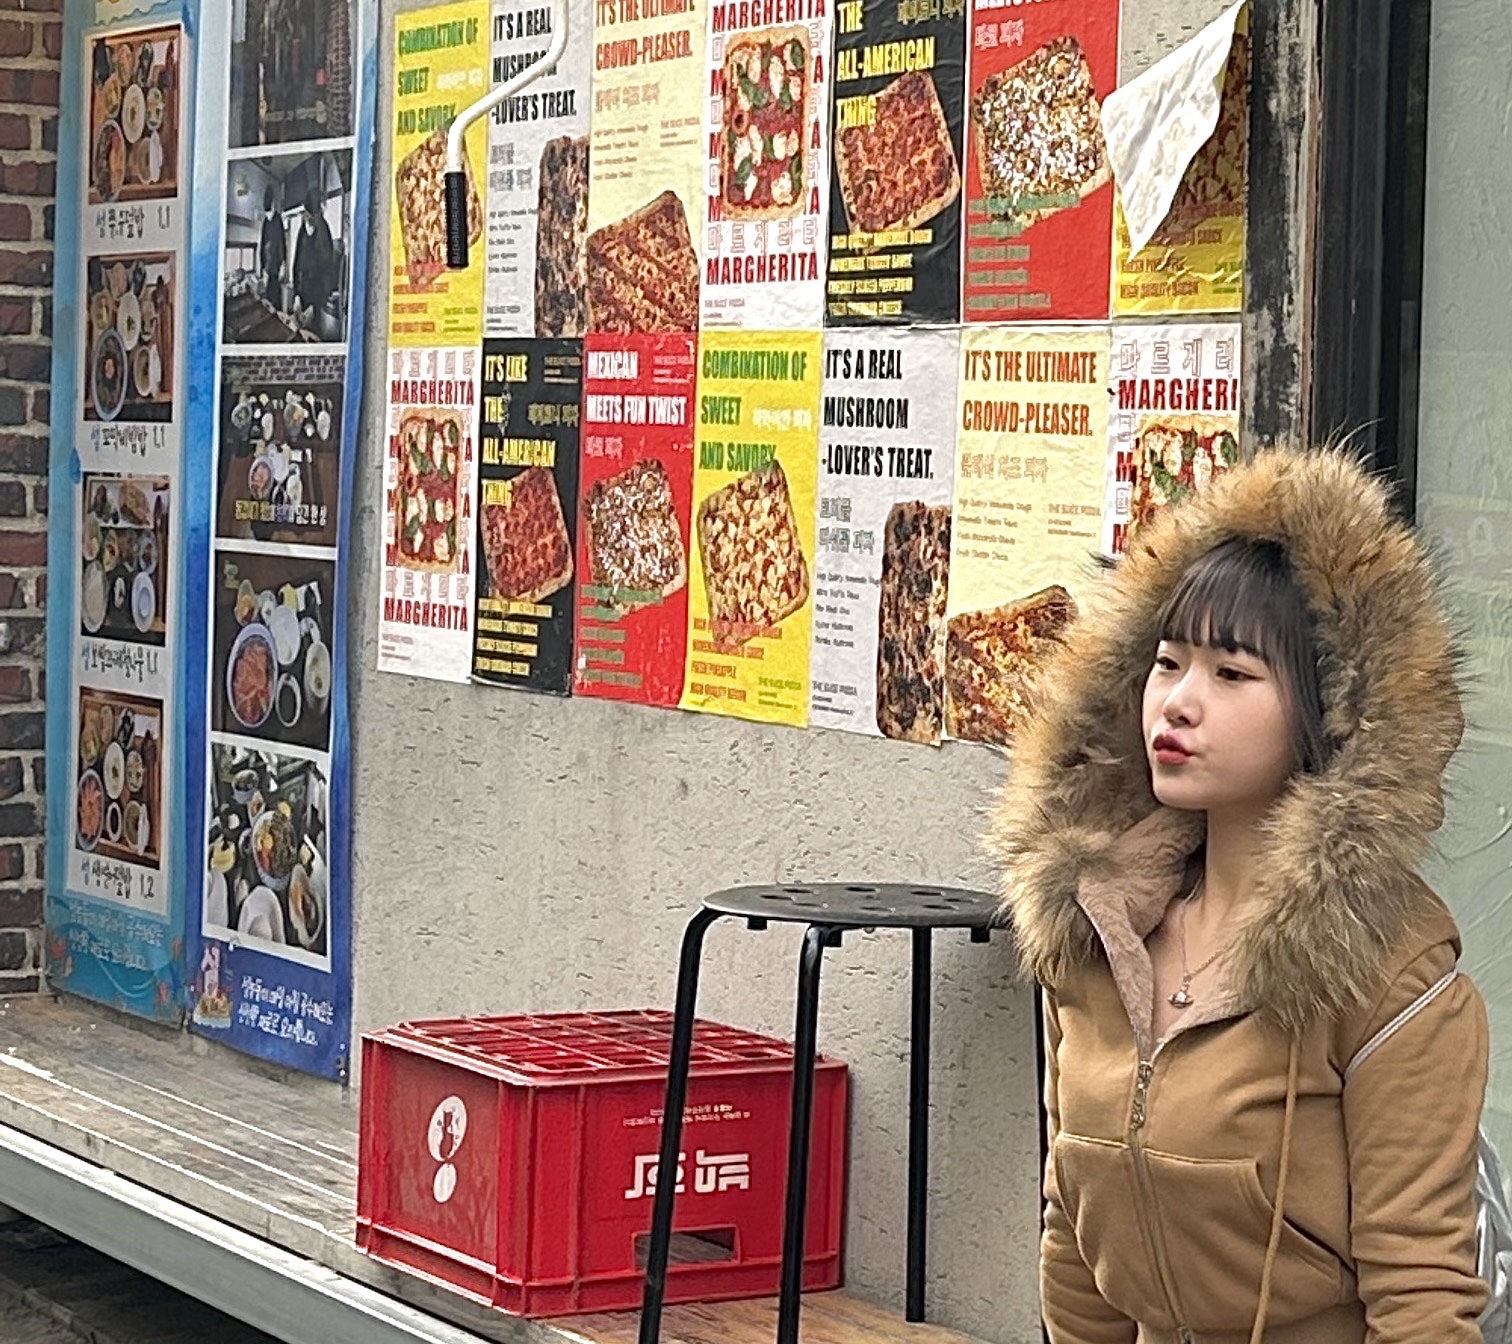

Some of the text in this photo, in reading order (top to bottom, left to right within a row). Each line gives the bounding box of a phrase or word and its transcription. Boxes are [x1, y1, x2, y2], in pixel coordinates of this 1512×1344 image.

[494, 7, 552, 42] IT'S A REAL
[838, 0, 863, 33] THE
[837, 36, 935, 82] ALL-AMERICAN
[706, 252, 818, 285] MARGHERITA
[485, 355, 504, 382] IT'S
[506, 355, 528, 382] LIKE
[587, 351, 638, 380] MEXICAN
[703, 350, 807, 381] COMBINATION OF
[825, 349, 902, 379] IT'S A REAL
[964, 350, 1097, 383] IT'S THE ULTIMATE
[391, 380, 474, 405] MARGHERITA
[484, 396, 504, 423] THE
[586, 395, 622, 422] MEETS
[624, 395, 646, 424] FUN
[649, 396, 687, 425] TWIST
[701, 396, 742, 425] SWEET
[824, 396, 909, 429] MUSHROOM
[963, 399, 1094, 436] CROWD-PLEASER.
[699, 441, 724, 470] AND
[888, 447, 934, 479] TREAT.
[384, 597, 468, 632] MARGHERITA
